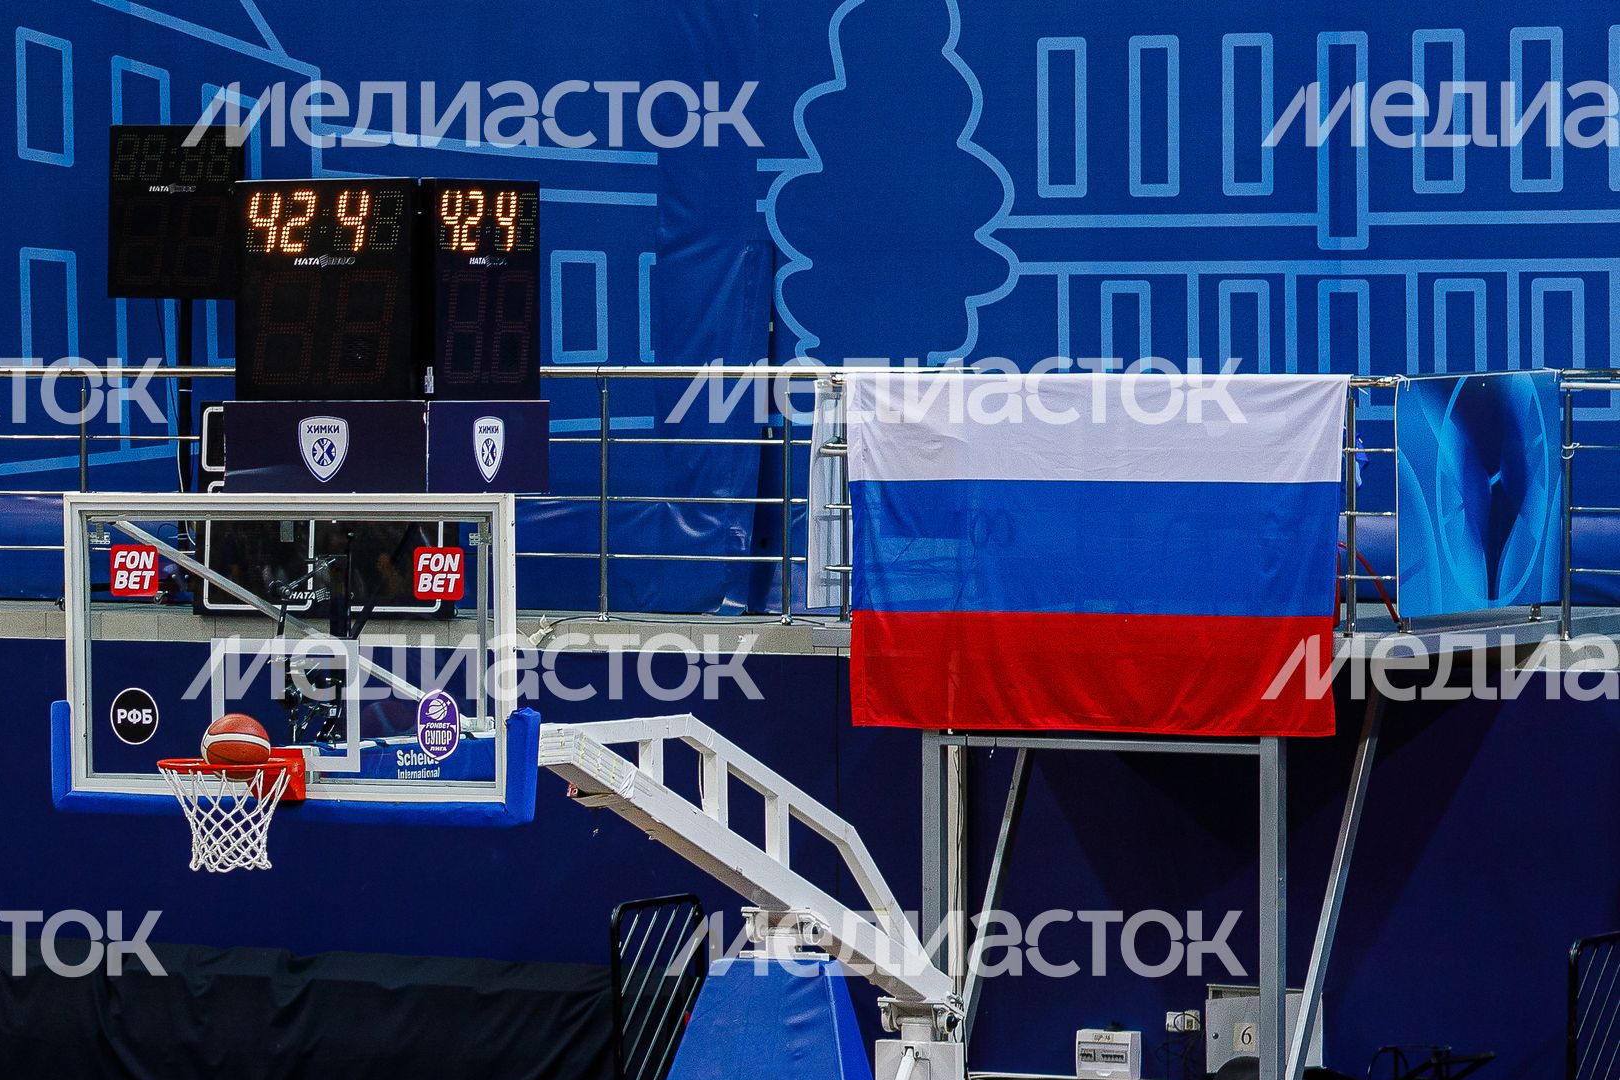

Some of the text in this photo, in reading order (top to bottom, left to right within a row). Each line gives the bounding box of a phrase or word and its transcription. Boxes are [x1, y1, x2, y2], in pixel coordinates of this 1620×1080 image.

[306, 425, 340, 434] ХИМКИ
[478, 425, 500, 434] ХИМКИ
[113, 551, 156, 570] FON
[417, 553, 461, 572] FON
[113, 570, 156, 590] BET
[417, 573, 461, 593] BET
[116, 708, 154, 725] РФБ
[397, 766, 440, 779] International
[1240, 1025, 1253, 1045] 6
